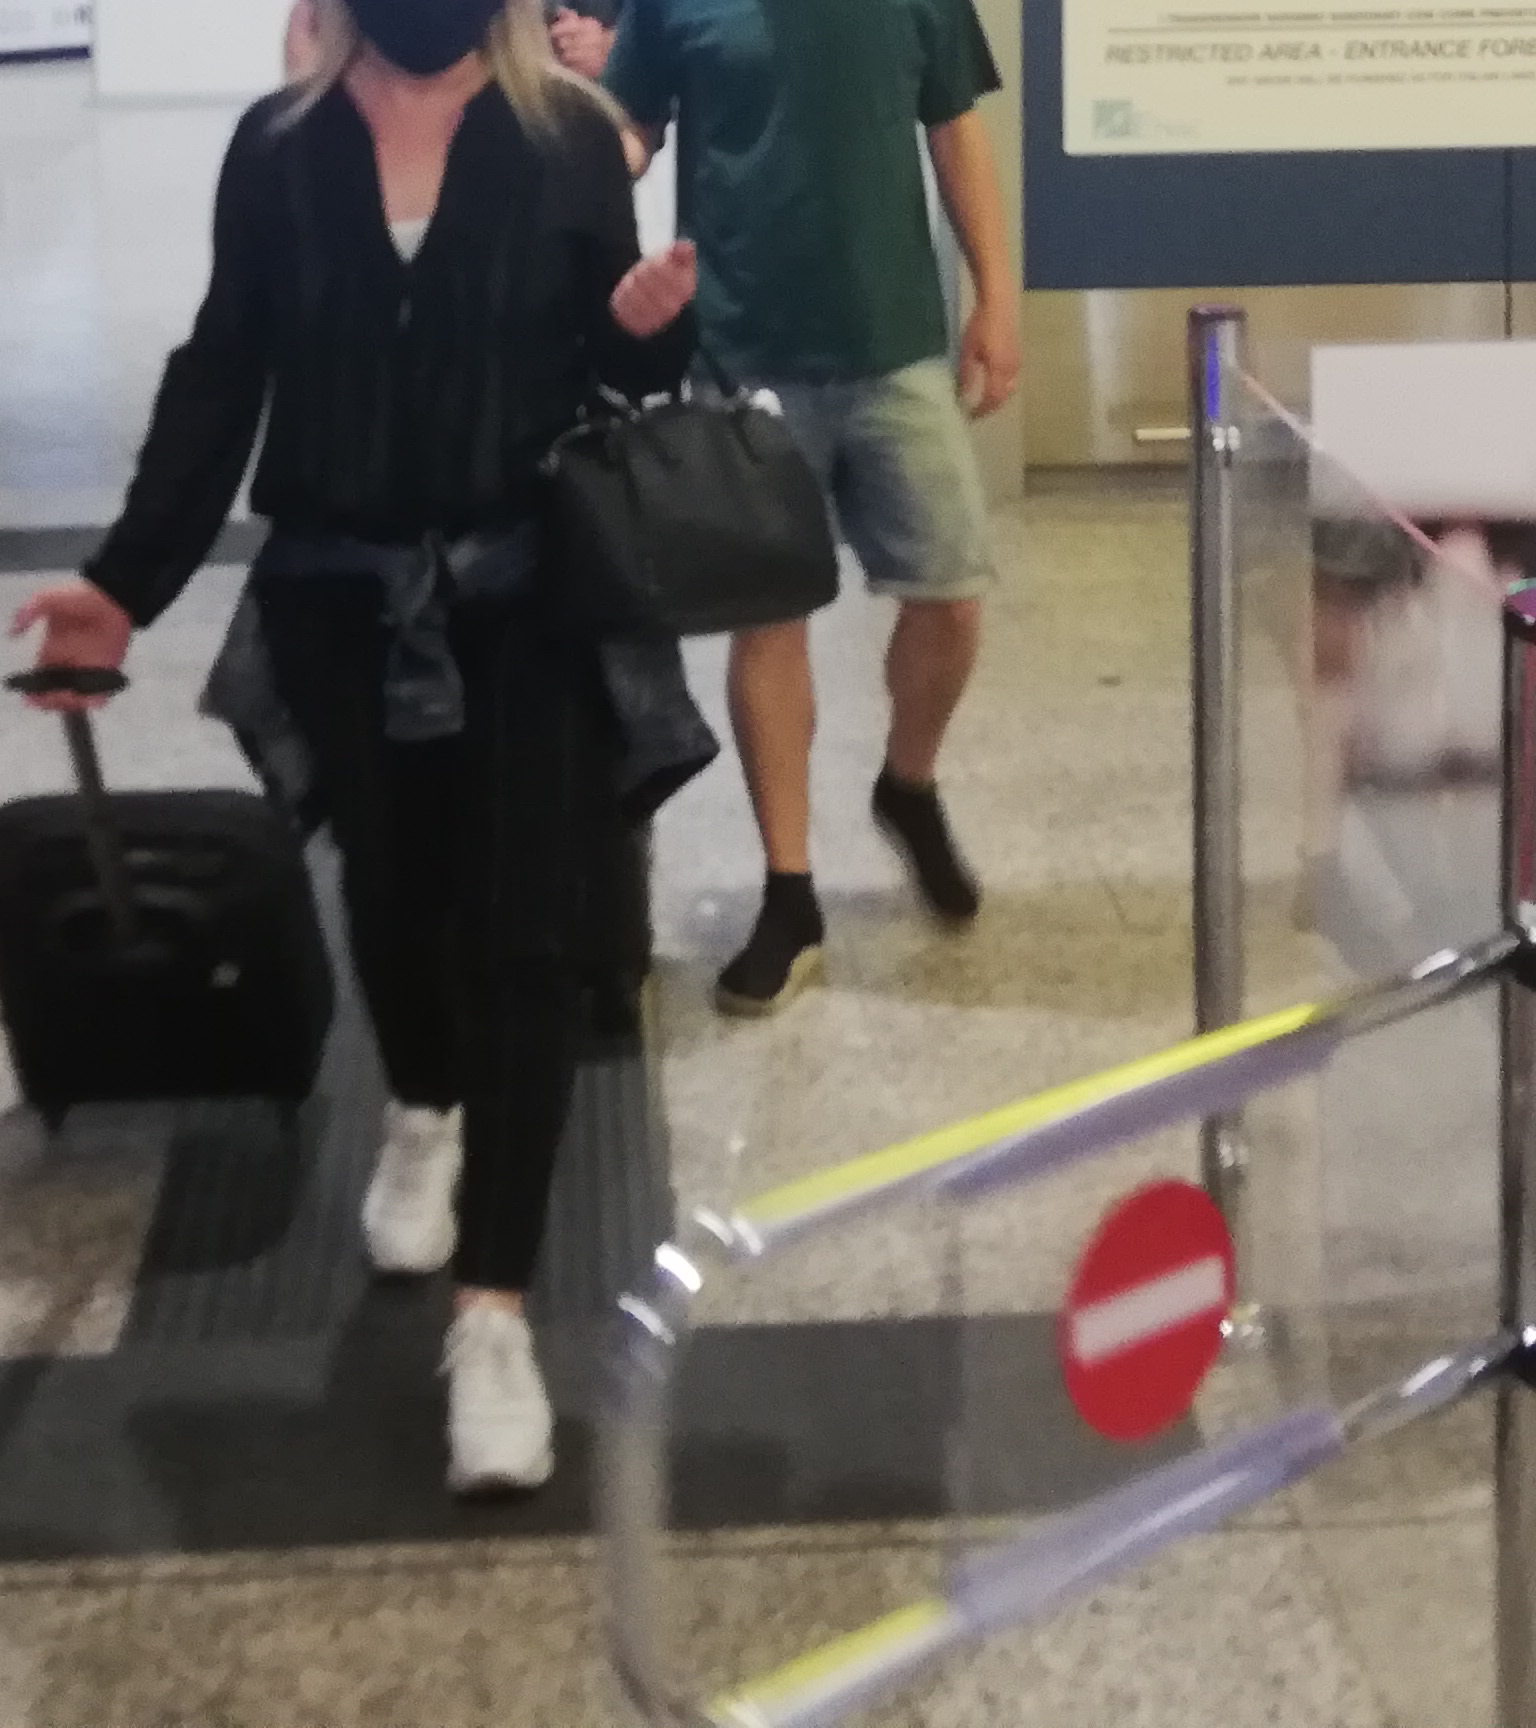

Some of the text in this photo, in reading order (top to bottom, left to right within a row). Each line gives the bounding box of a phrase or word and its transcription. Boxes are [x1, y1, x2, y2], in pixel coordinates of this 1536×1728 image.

[1104, 42, 1254, 64] RESTRICTED
[1258, 41, 1322, 62] AREA
[1344, 38, 1471, 61] ENTRANCE
